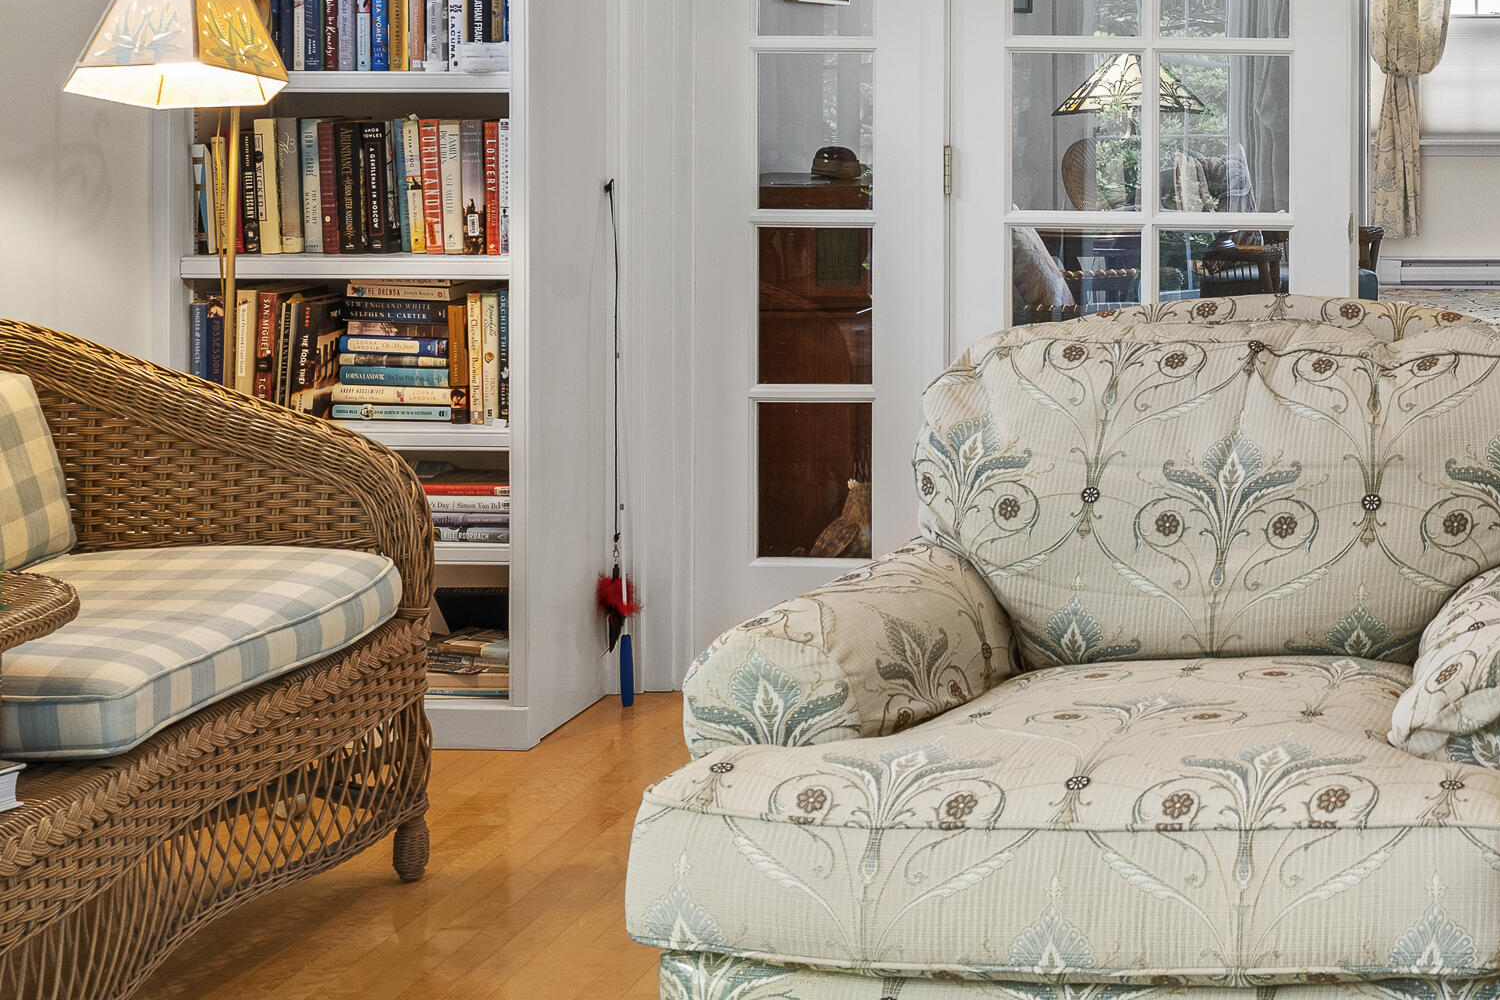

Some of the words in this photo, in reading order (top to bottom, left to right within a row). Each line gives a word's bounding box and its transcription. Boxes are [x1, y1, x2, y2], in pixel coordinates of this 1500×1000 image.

[421, 126, 439, 222] FORDLANDIA
[486, 139, 497, 191] LOTTERY
[256, 166, 264, 207] WICKED
[262, 298, 270, 315] SAN
[261, 319, 269, 351] MIGUEL
